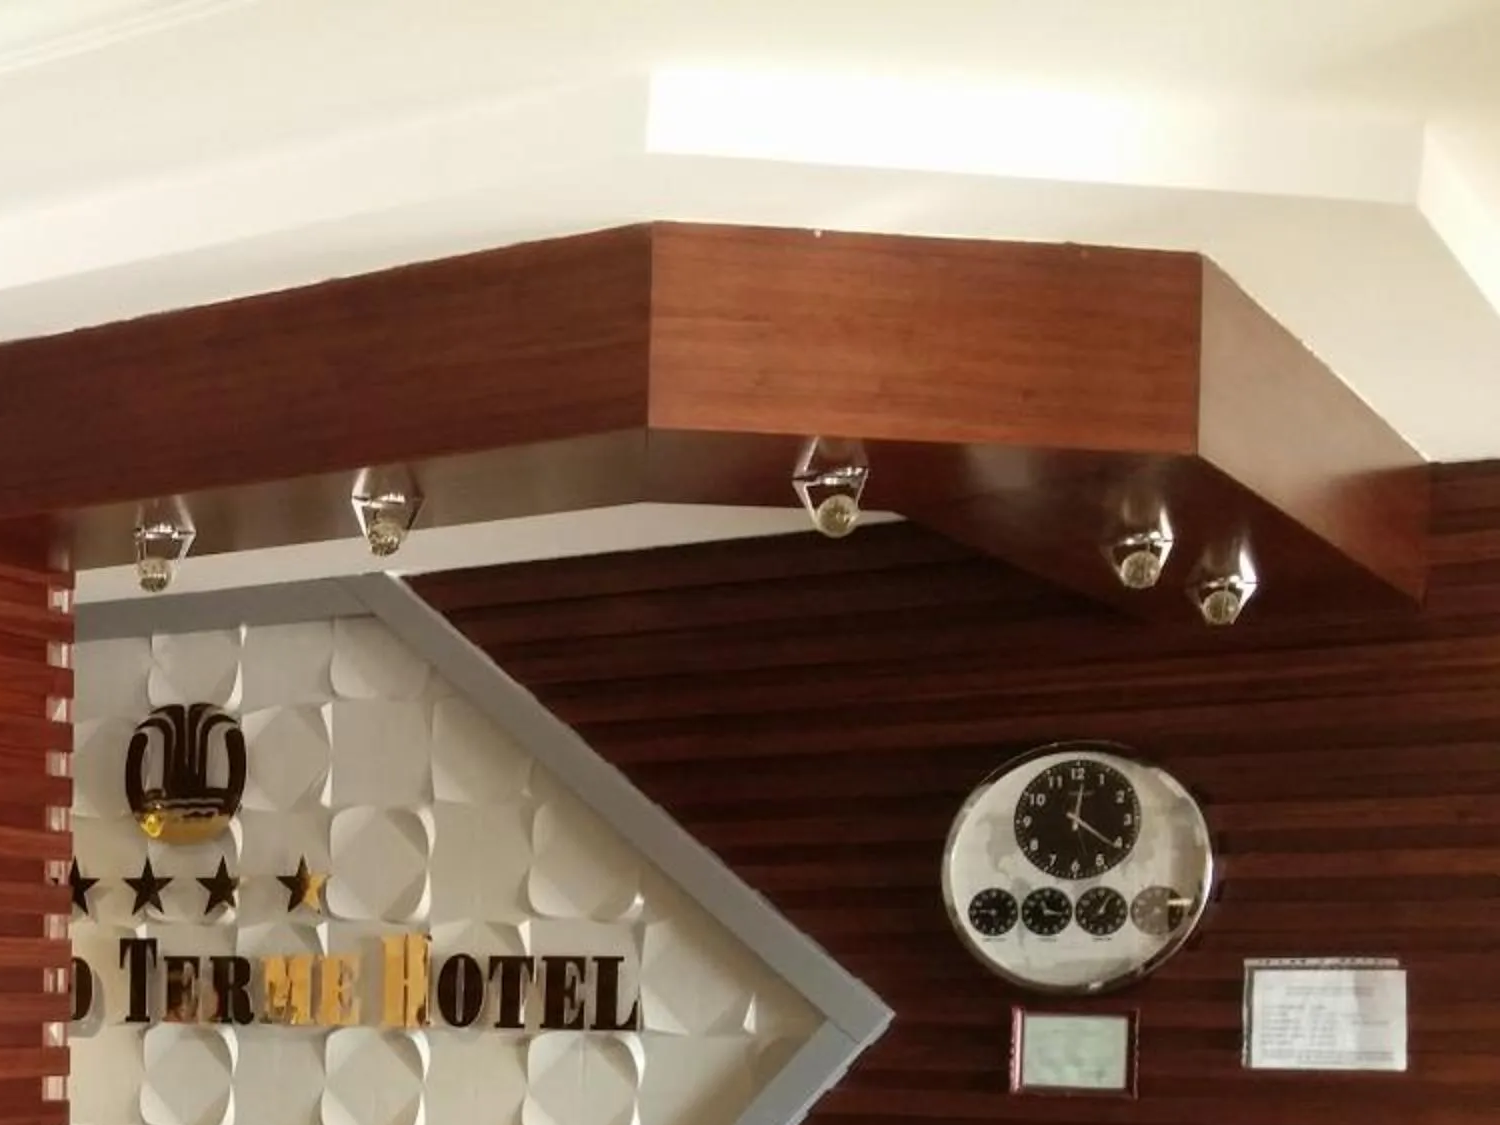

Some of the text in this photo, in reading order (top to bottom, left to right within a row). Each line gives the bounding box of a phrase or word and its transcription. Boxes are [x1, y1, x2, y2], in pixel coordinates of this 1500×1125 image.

[1071, 767, 1085, 780] 12
[1048, 775, 1062, 789] 11
[1030, 793, 1046, 807] 10
[1115, 790, 1125, 804] 2
[1023, 815, 1032, 828] 9
[1123, 813, 1133, 826] 3
[119, 938, 358, 1026] TERME
[383, 934, 640, 1031] HOTEL
